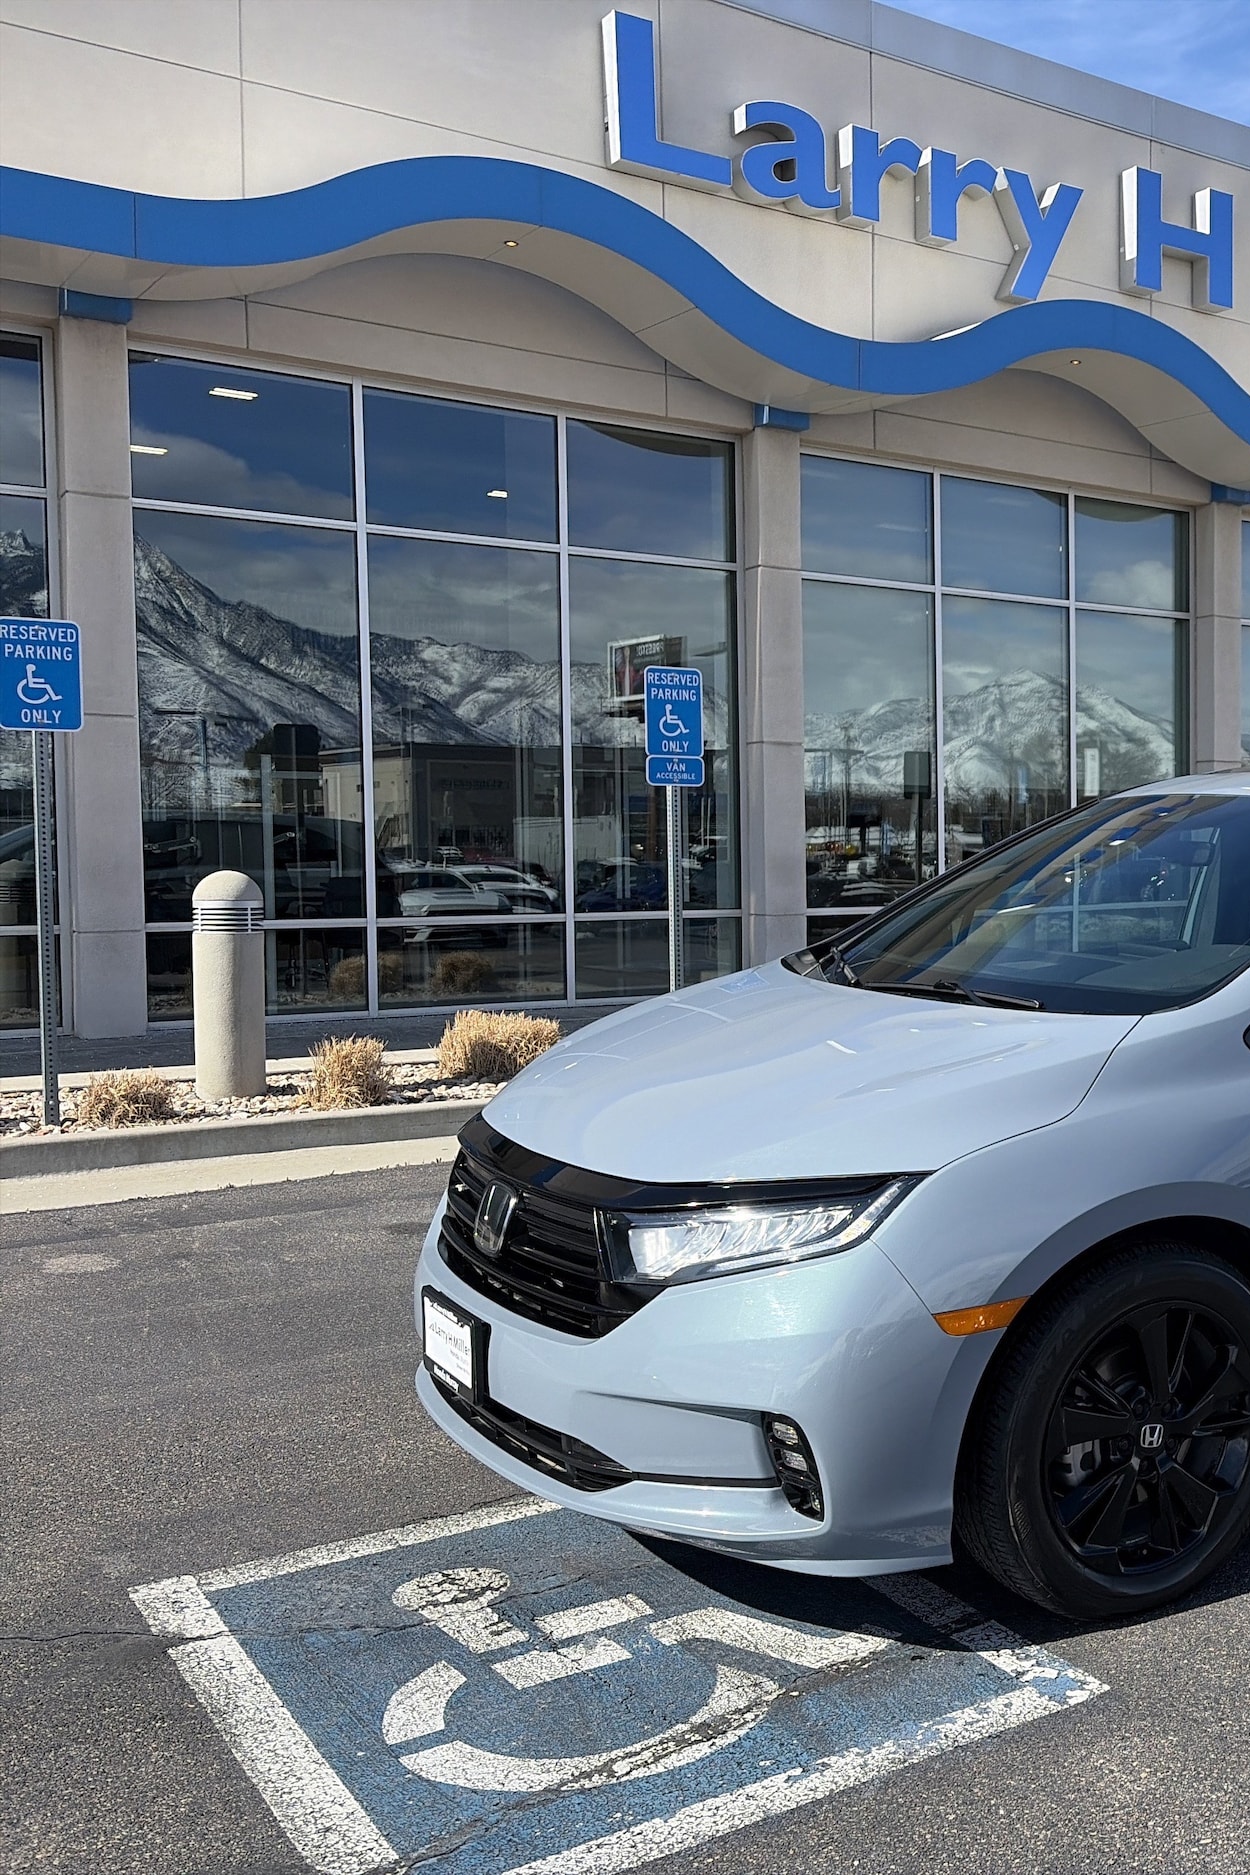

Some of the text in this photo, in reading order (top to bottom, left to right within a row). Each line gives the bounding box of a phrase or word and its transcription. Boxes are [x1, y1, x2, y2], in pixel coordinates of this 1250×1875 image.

[602, 8, 1084, 303] Larry
[1120, 165, 1234, 313] H
[0, 624, 77, 642] RESERVED
[4, 643, 73, 661] PARKING
[647, 672, 700, 687] RESERVED
[651, 687, 697, 702] PARKING
[21, 708, 62, 724] ONLY
[661, 740, 690, 753] ONLY
[666, 762, 686, 773] VAN
[656, 772, 696, 780] ACCESSIBLE
